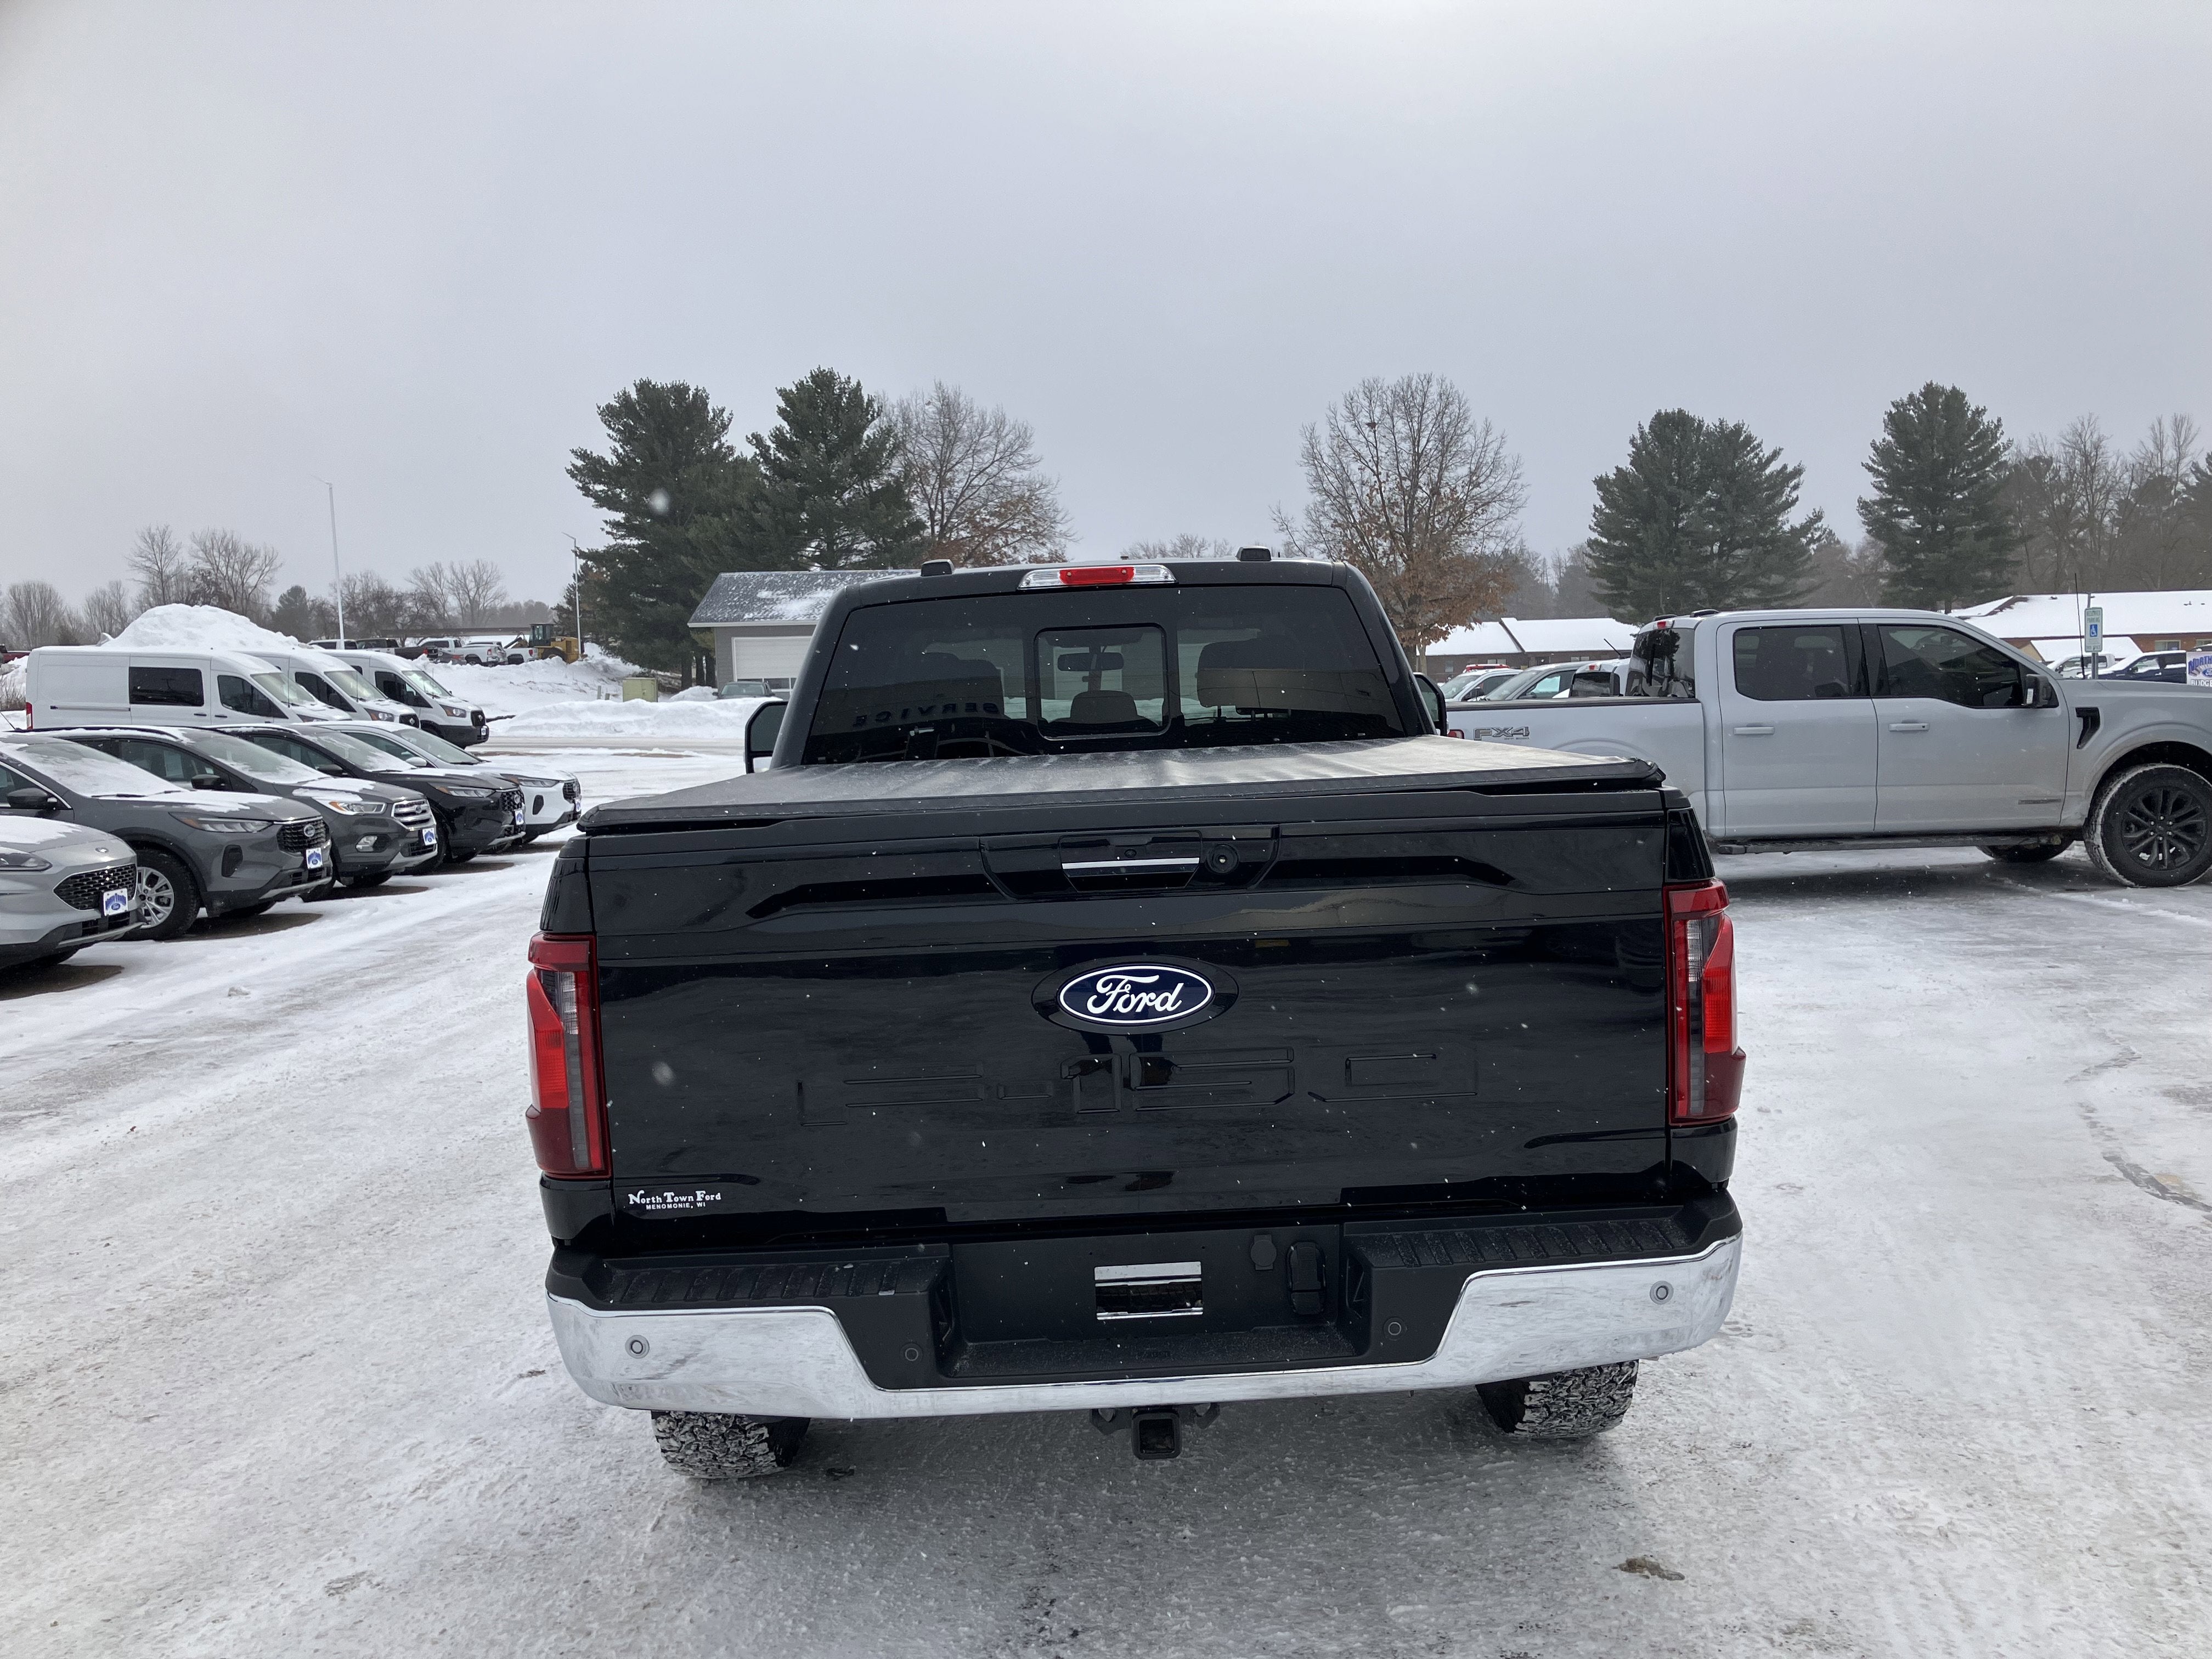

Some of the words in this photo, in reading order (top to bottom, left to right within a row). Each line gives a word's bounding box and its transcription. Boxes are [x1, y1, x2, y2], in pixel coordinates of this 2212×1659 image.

[1474, 726, 1530, 741] FX4
[1086, 974, 1184, 1014] Ford
[628, 1189, 663, 1205] North
[663, 1192, 695, 1203] Town
[695, 1190, 722, 1201] Ford
